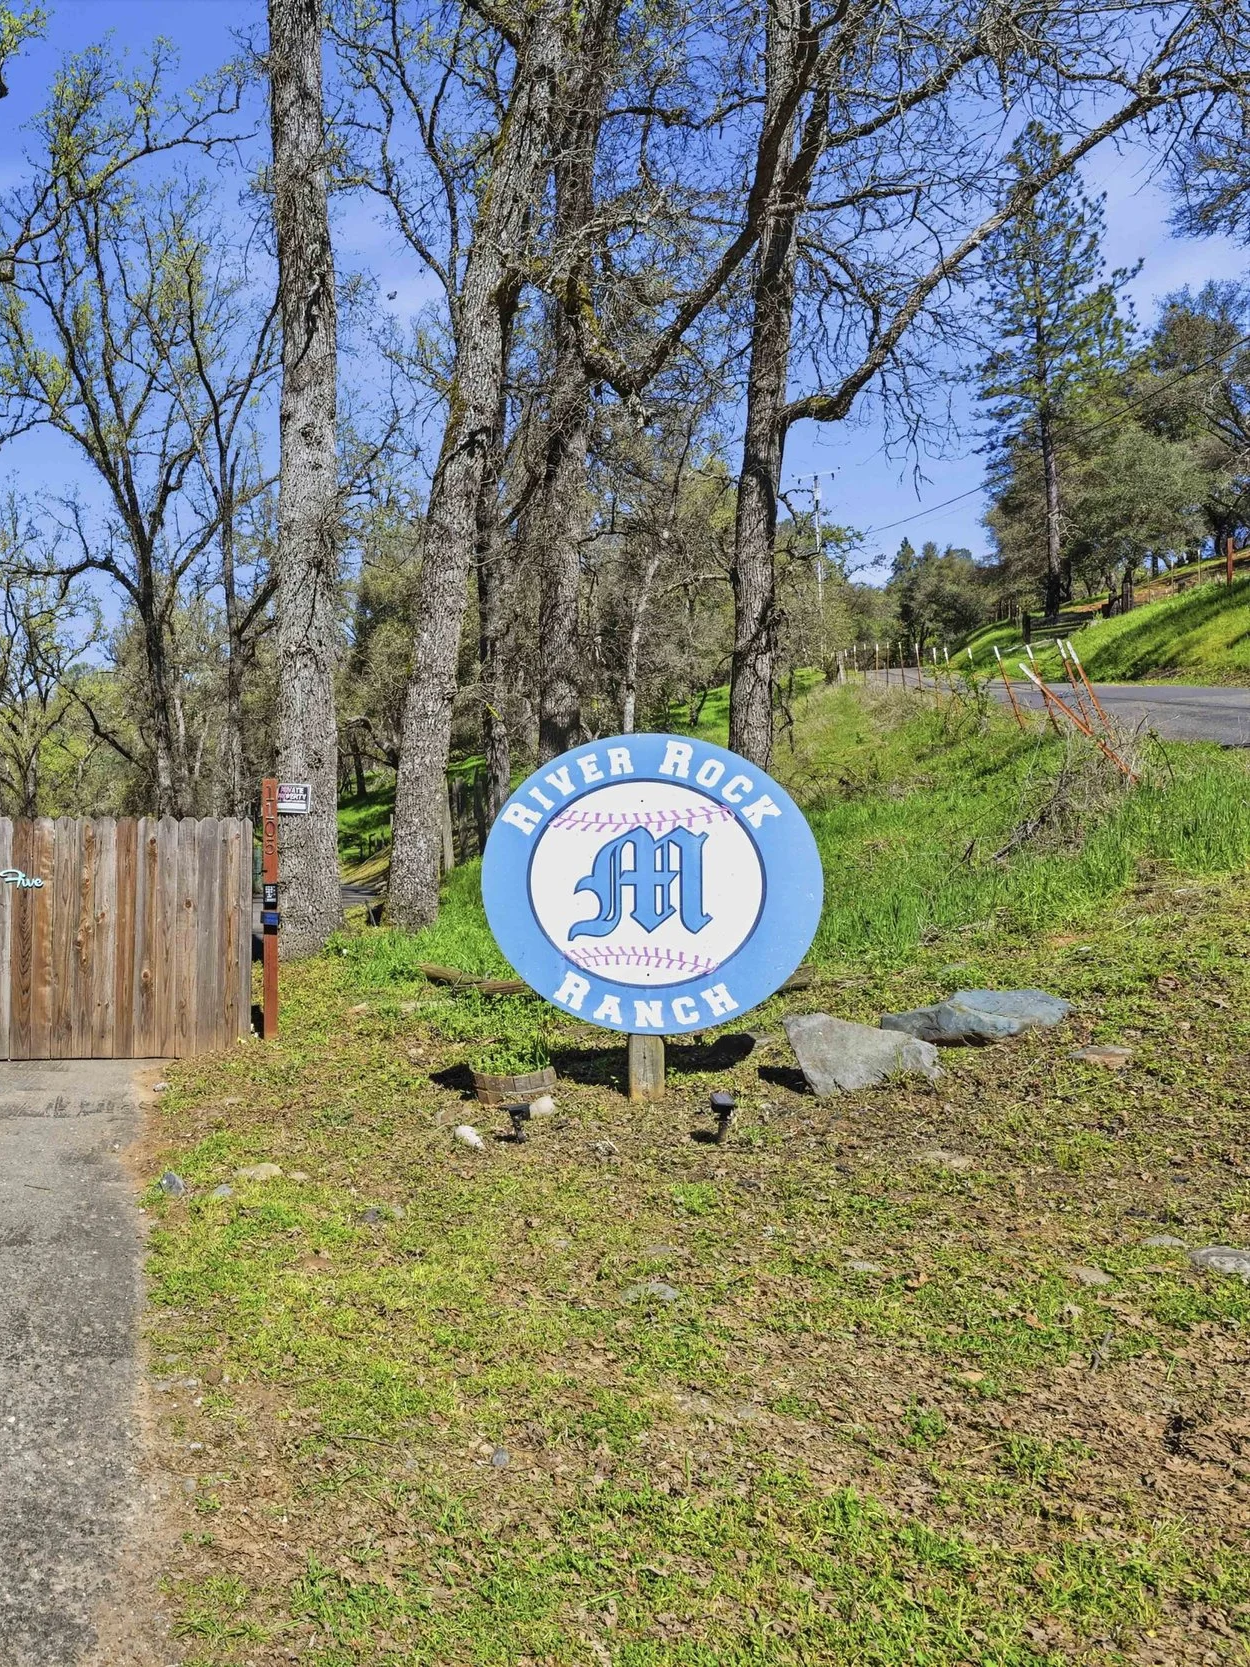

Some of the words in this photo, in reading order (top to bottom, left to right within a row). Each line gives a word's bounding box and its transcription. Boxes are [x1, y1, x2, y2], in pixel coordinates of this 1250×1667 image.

[265, 785, 276, 855] 1105
[501, 747, 634, 836] RIVER
[658, 740, 782, 829] ROCK
[0, 869, 44, 889] Five
[568, 825, 713, 941] M
[553, 971, 739, 1028] RANCH
